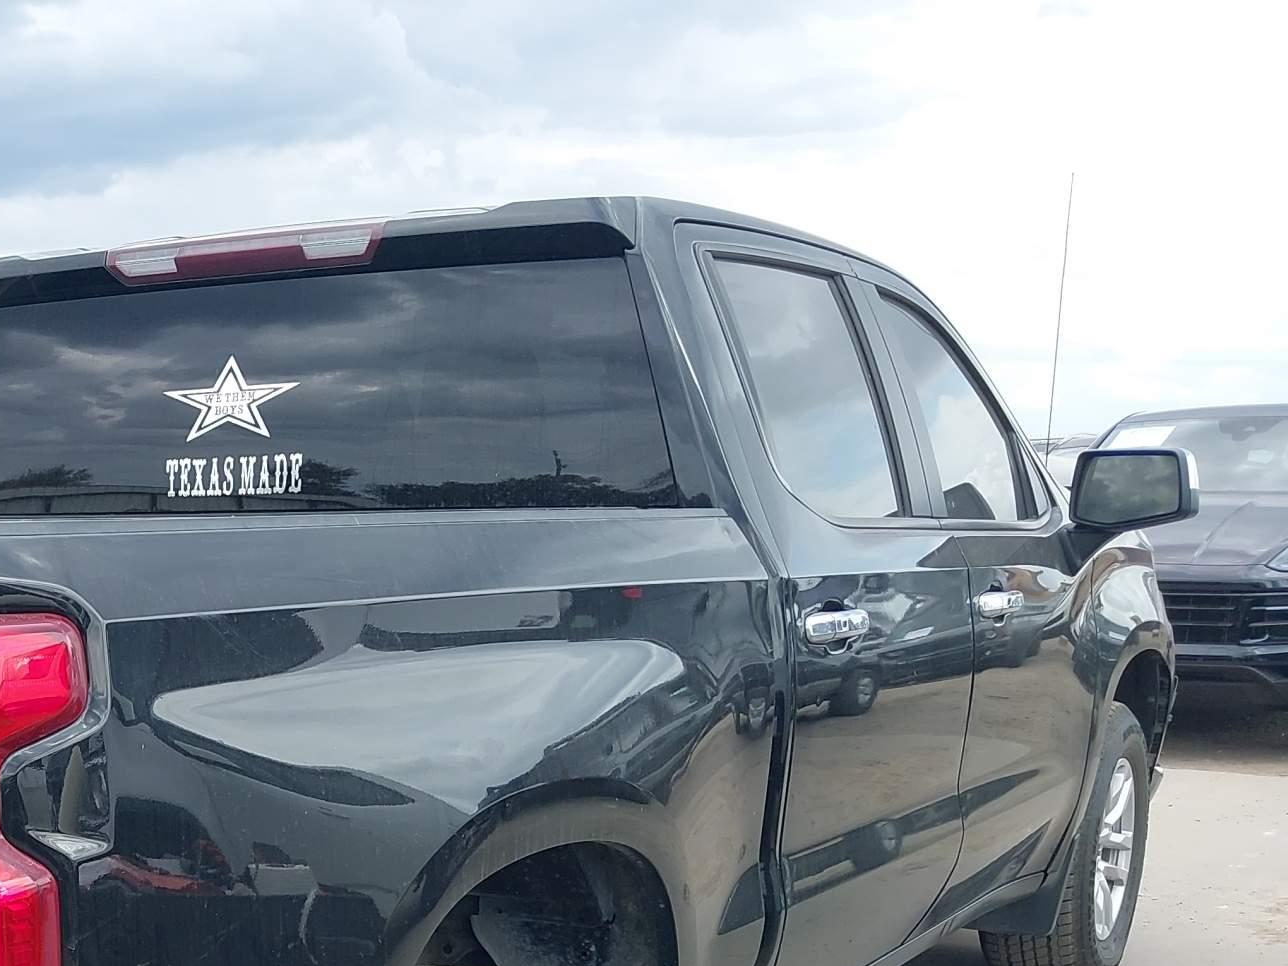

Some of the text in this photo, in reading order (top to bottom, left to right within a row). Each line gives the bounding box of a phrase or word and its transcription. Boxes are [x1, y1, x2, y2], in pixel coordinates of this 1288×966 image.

[204, 391, 255, 403] WE THEM
[215, 405, 244, 416] BOYS
[166, 453, 304, 498] TEXAS MADE
